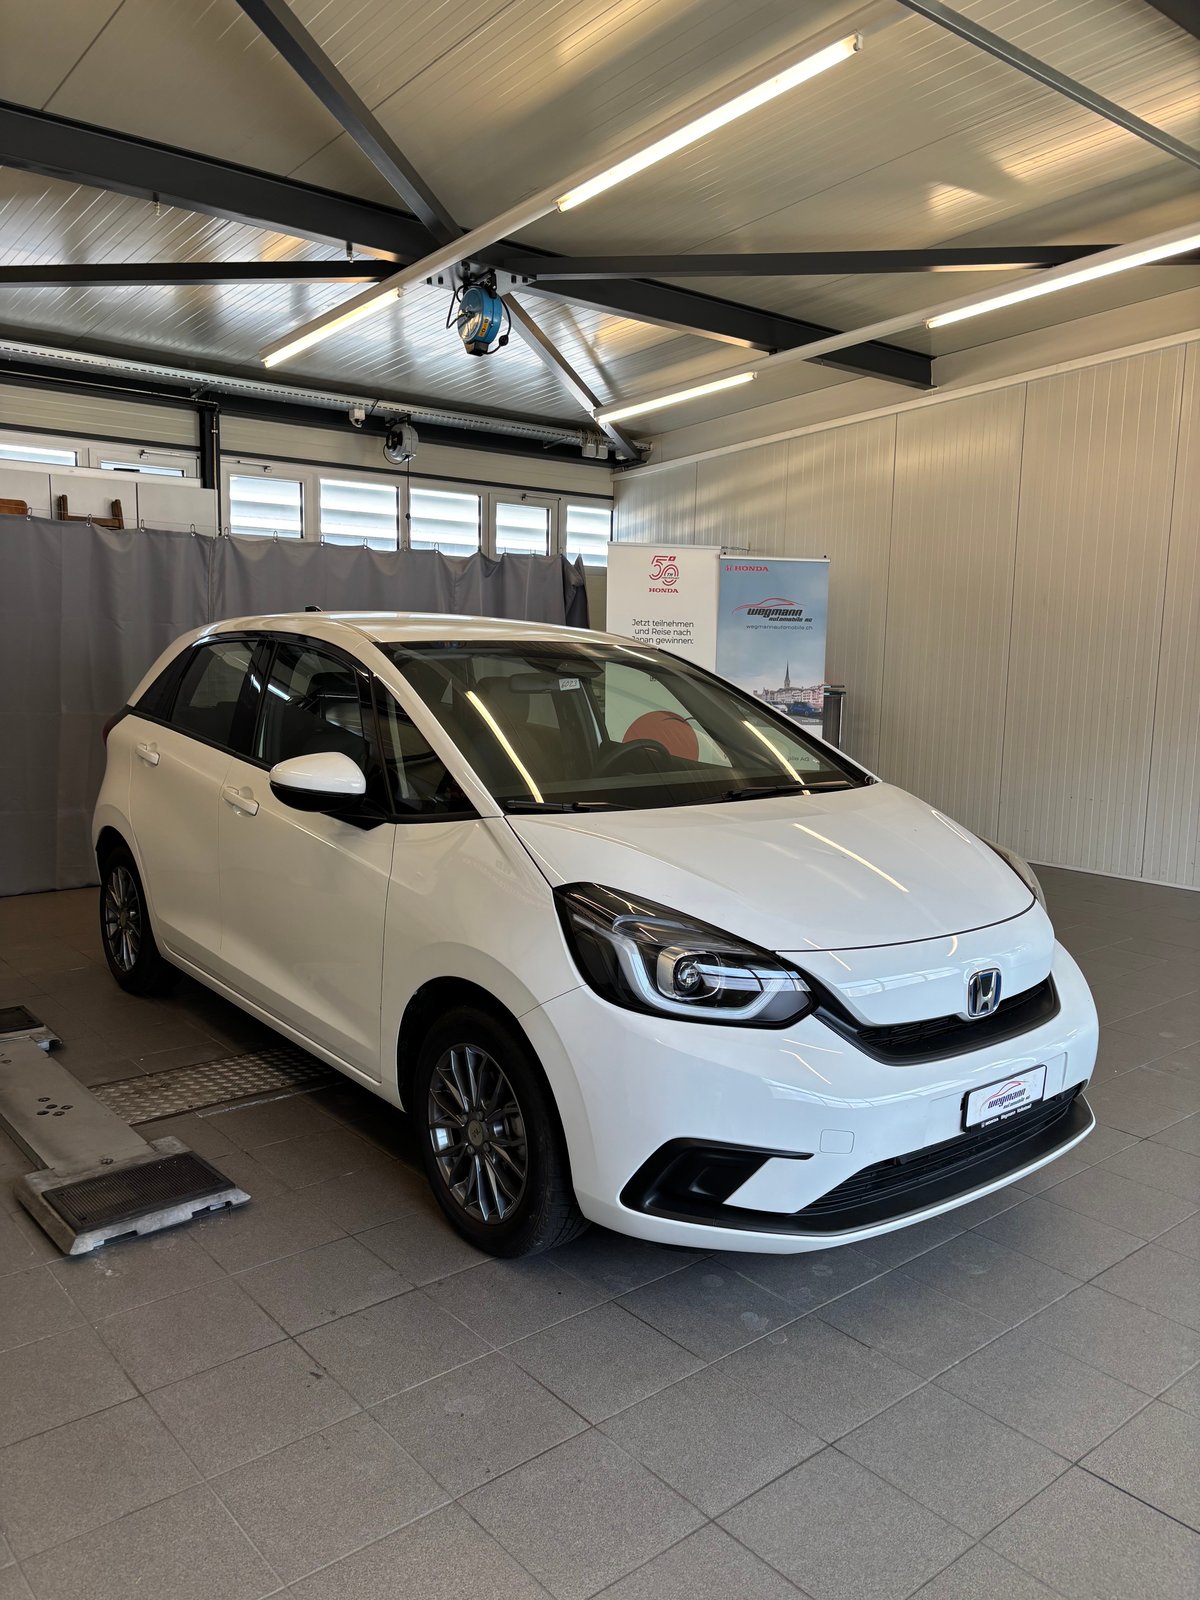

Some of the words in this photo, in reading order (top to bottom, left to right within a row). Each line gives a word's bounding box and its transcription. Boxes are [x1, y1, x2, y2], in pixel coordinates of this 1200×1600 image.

[746, 607, 803, 618] wegmann
[652, 619, 694, 627] teilnehmen
[987, 1087, 1026, 1109] wegmann
